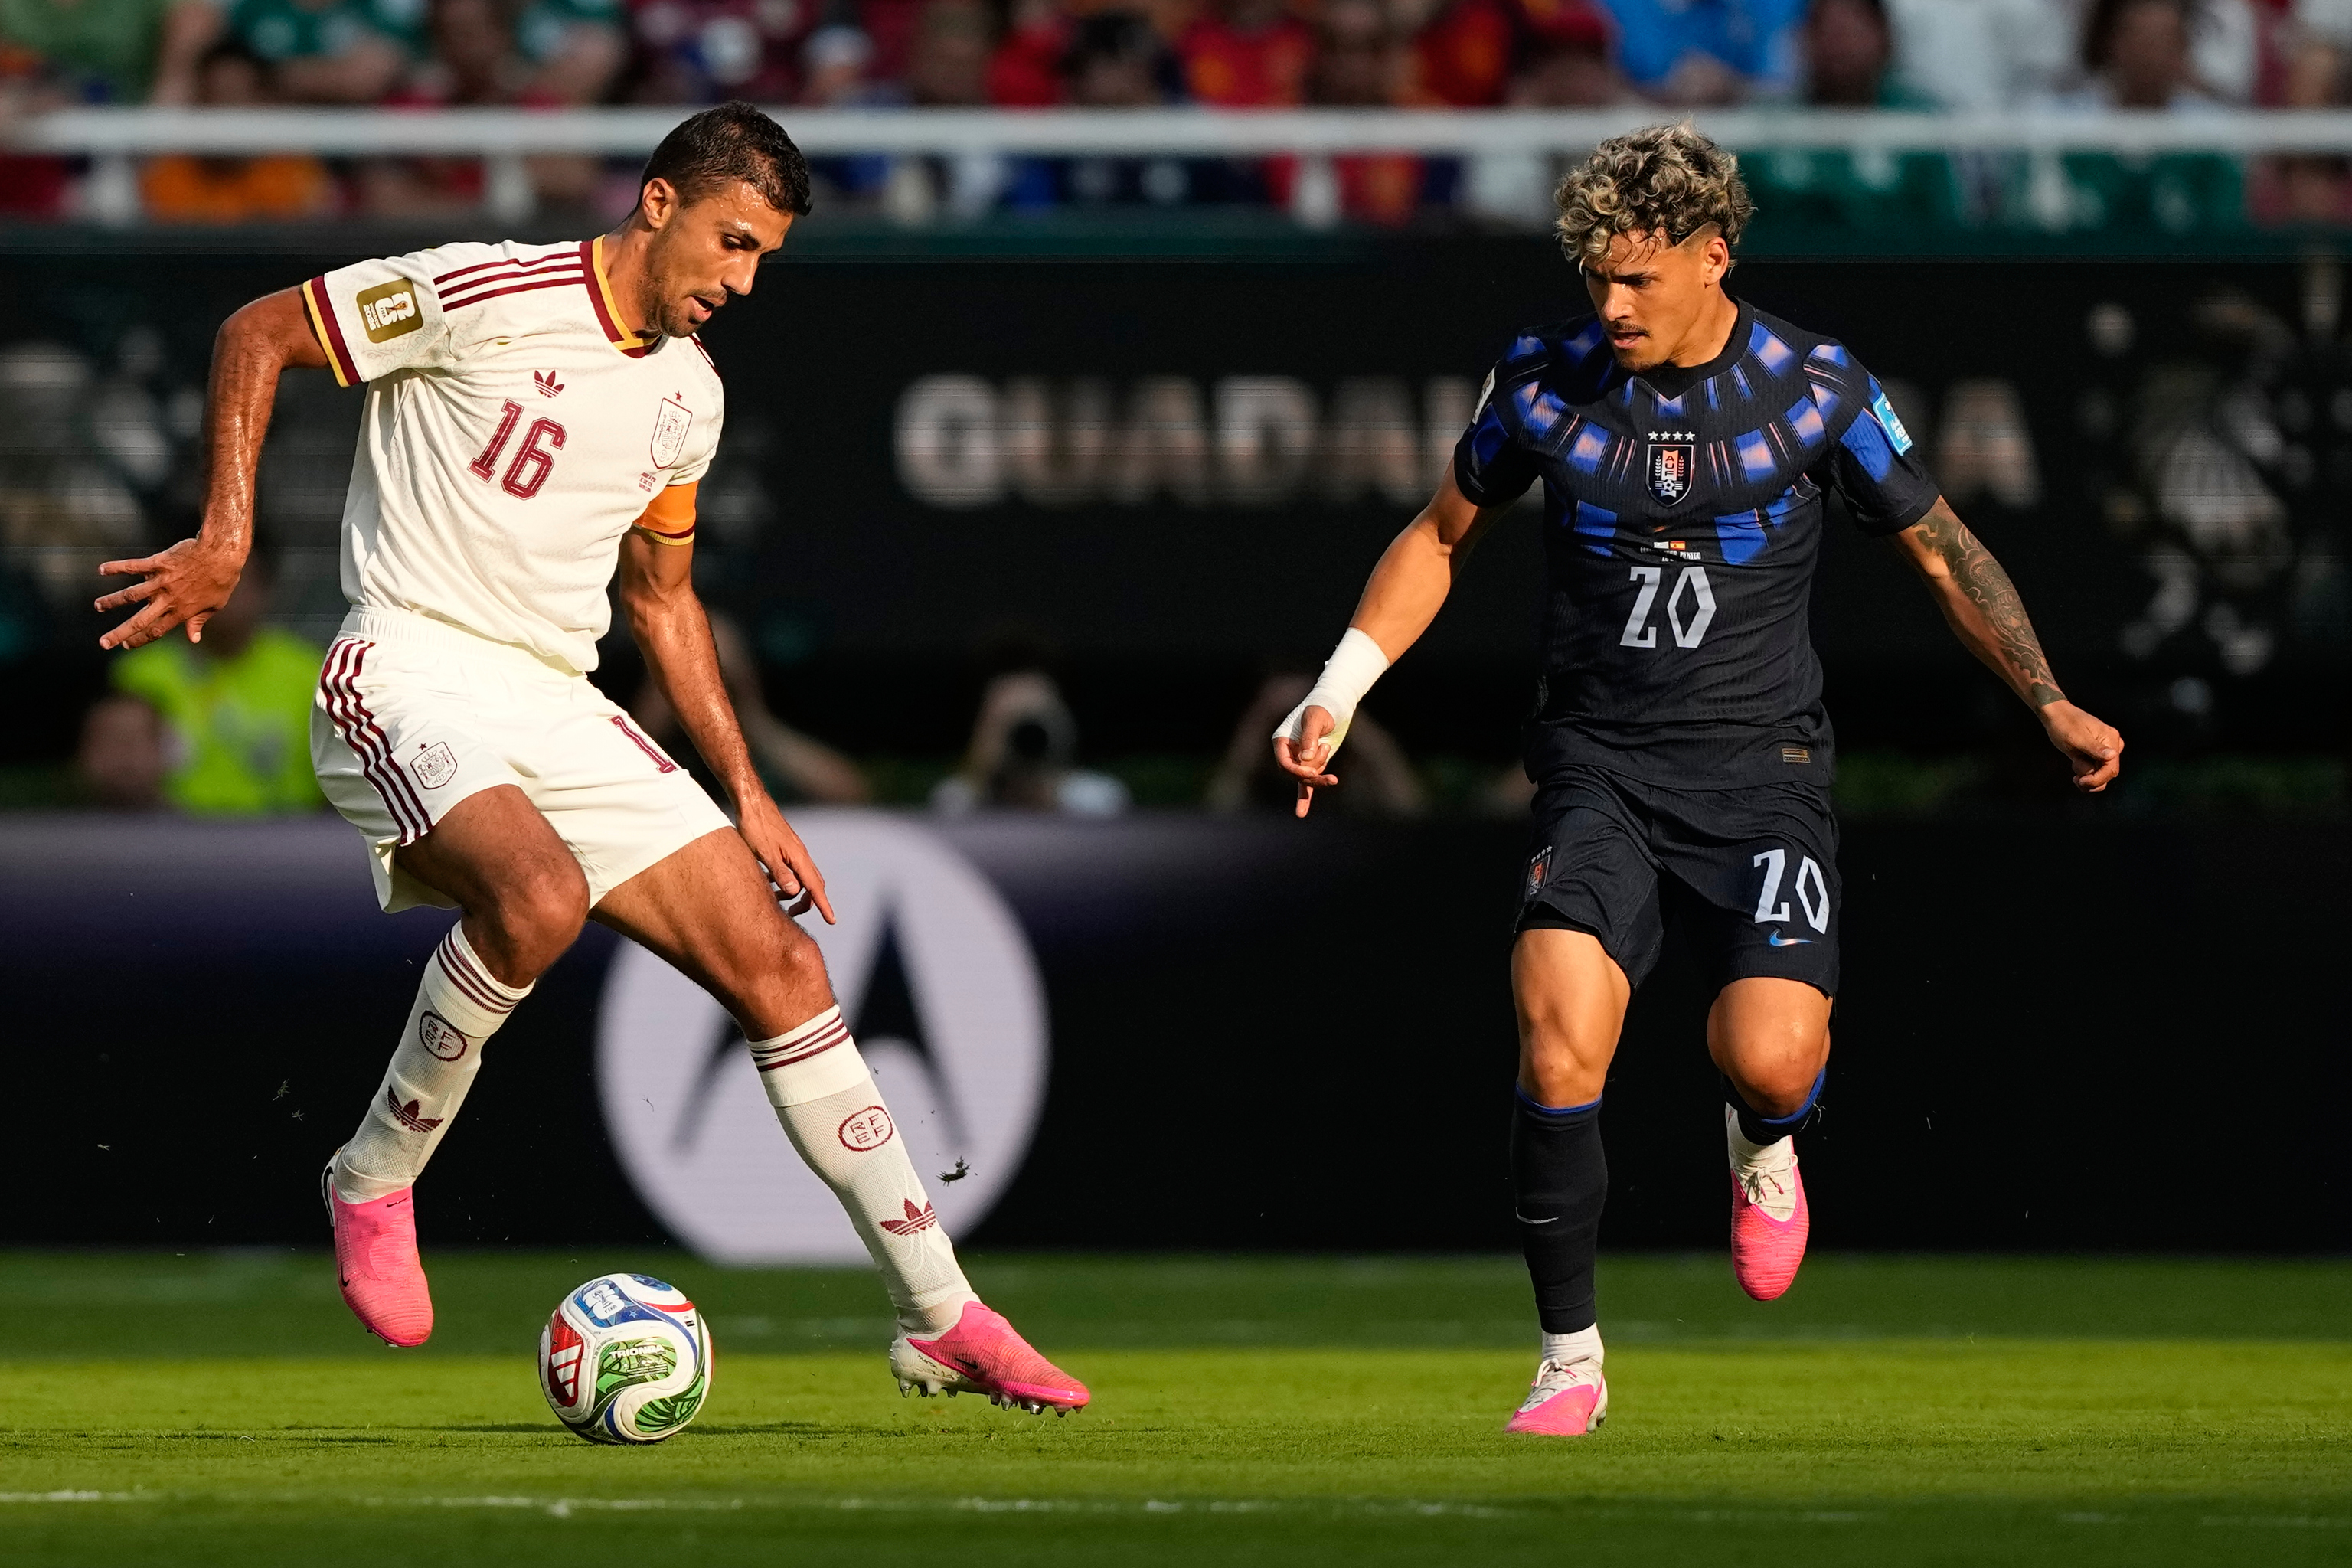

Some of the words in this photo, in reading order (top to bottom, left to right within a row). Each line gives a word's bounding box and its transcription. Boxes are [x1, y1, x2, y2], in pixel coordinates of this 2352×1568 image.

[363, 304, 376, 330] 2026
[466, 398, 568, 501] 16
[1619, 566, 1717, 648] 20
[1753, 848, 1830, 935] 20
